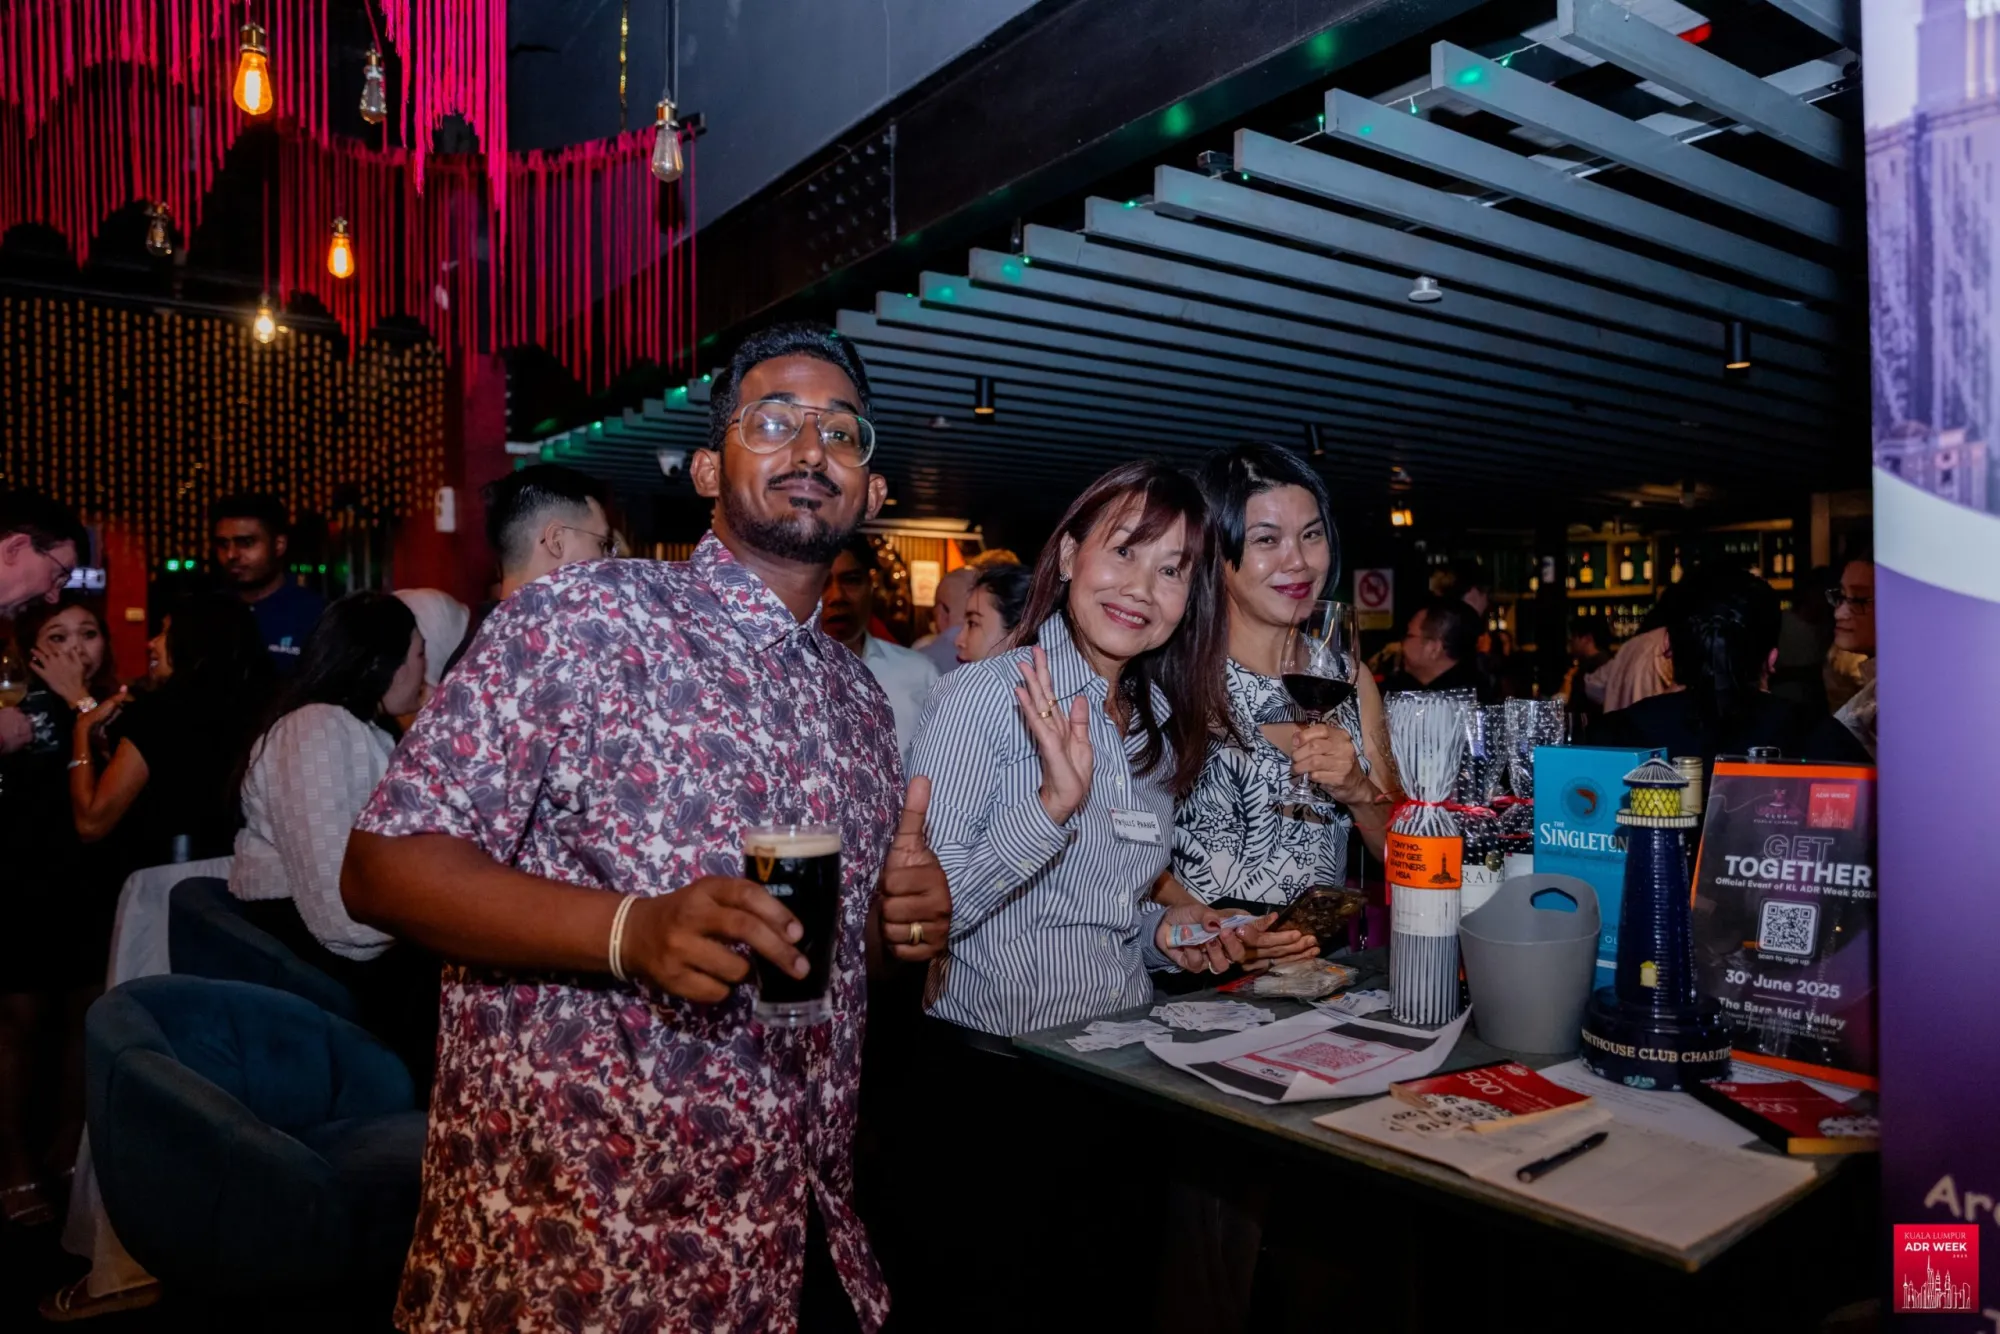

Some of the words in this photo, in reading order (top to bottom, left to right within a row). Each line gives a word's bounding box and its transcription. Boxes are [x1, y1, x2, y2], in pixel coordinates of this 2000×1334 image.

[1540, 823, 1630, 854] SINGLETON
[1763, 834, 1835, 862] GET
[1725, 855, 1873, 888] TOGETHER
[1715, 877, 1745, 888] Official
[1747, 880, 1772, 890] Event
[1774, 881, 1784, 890] of
[1786, 883, 1797, 892] KL
[1800, 885, 1820, 894] ADR
[1823, 887, 1849, 897] Week
[1784, 956, 1799, 965] sign
[1753, 974, 1793, 992] June
[1796, 980, 1841, 999] 2025
[1719, 996, 1740, 1010] The
[1777, 1007, 1800, 1020] Mid
[1805, 1011, 1847, 1031] Valley
[1638, 1048, 1679, 1063] CLUB
[1681, 1045, 1732, 1064] CHARITI
[1456, 1071, 1504, 1096] 500
[1924, 1173, 2000, 1229] Ar
